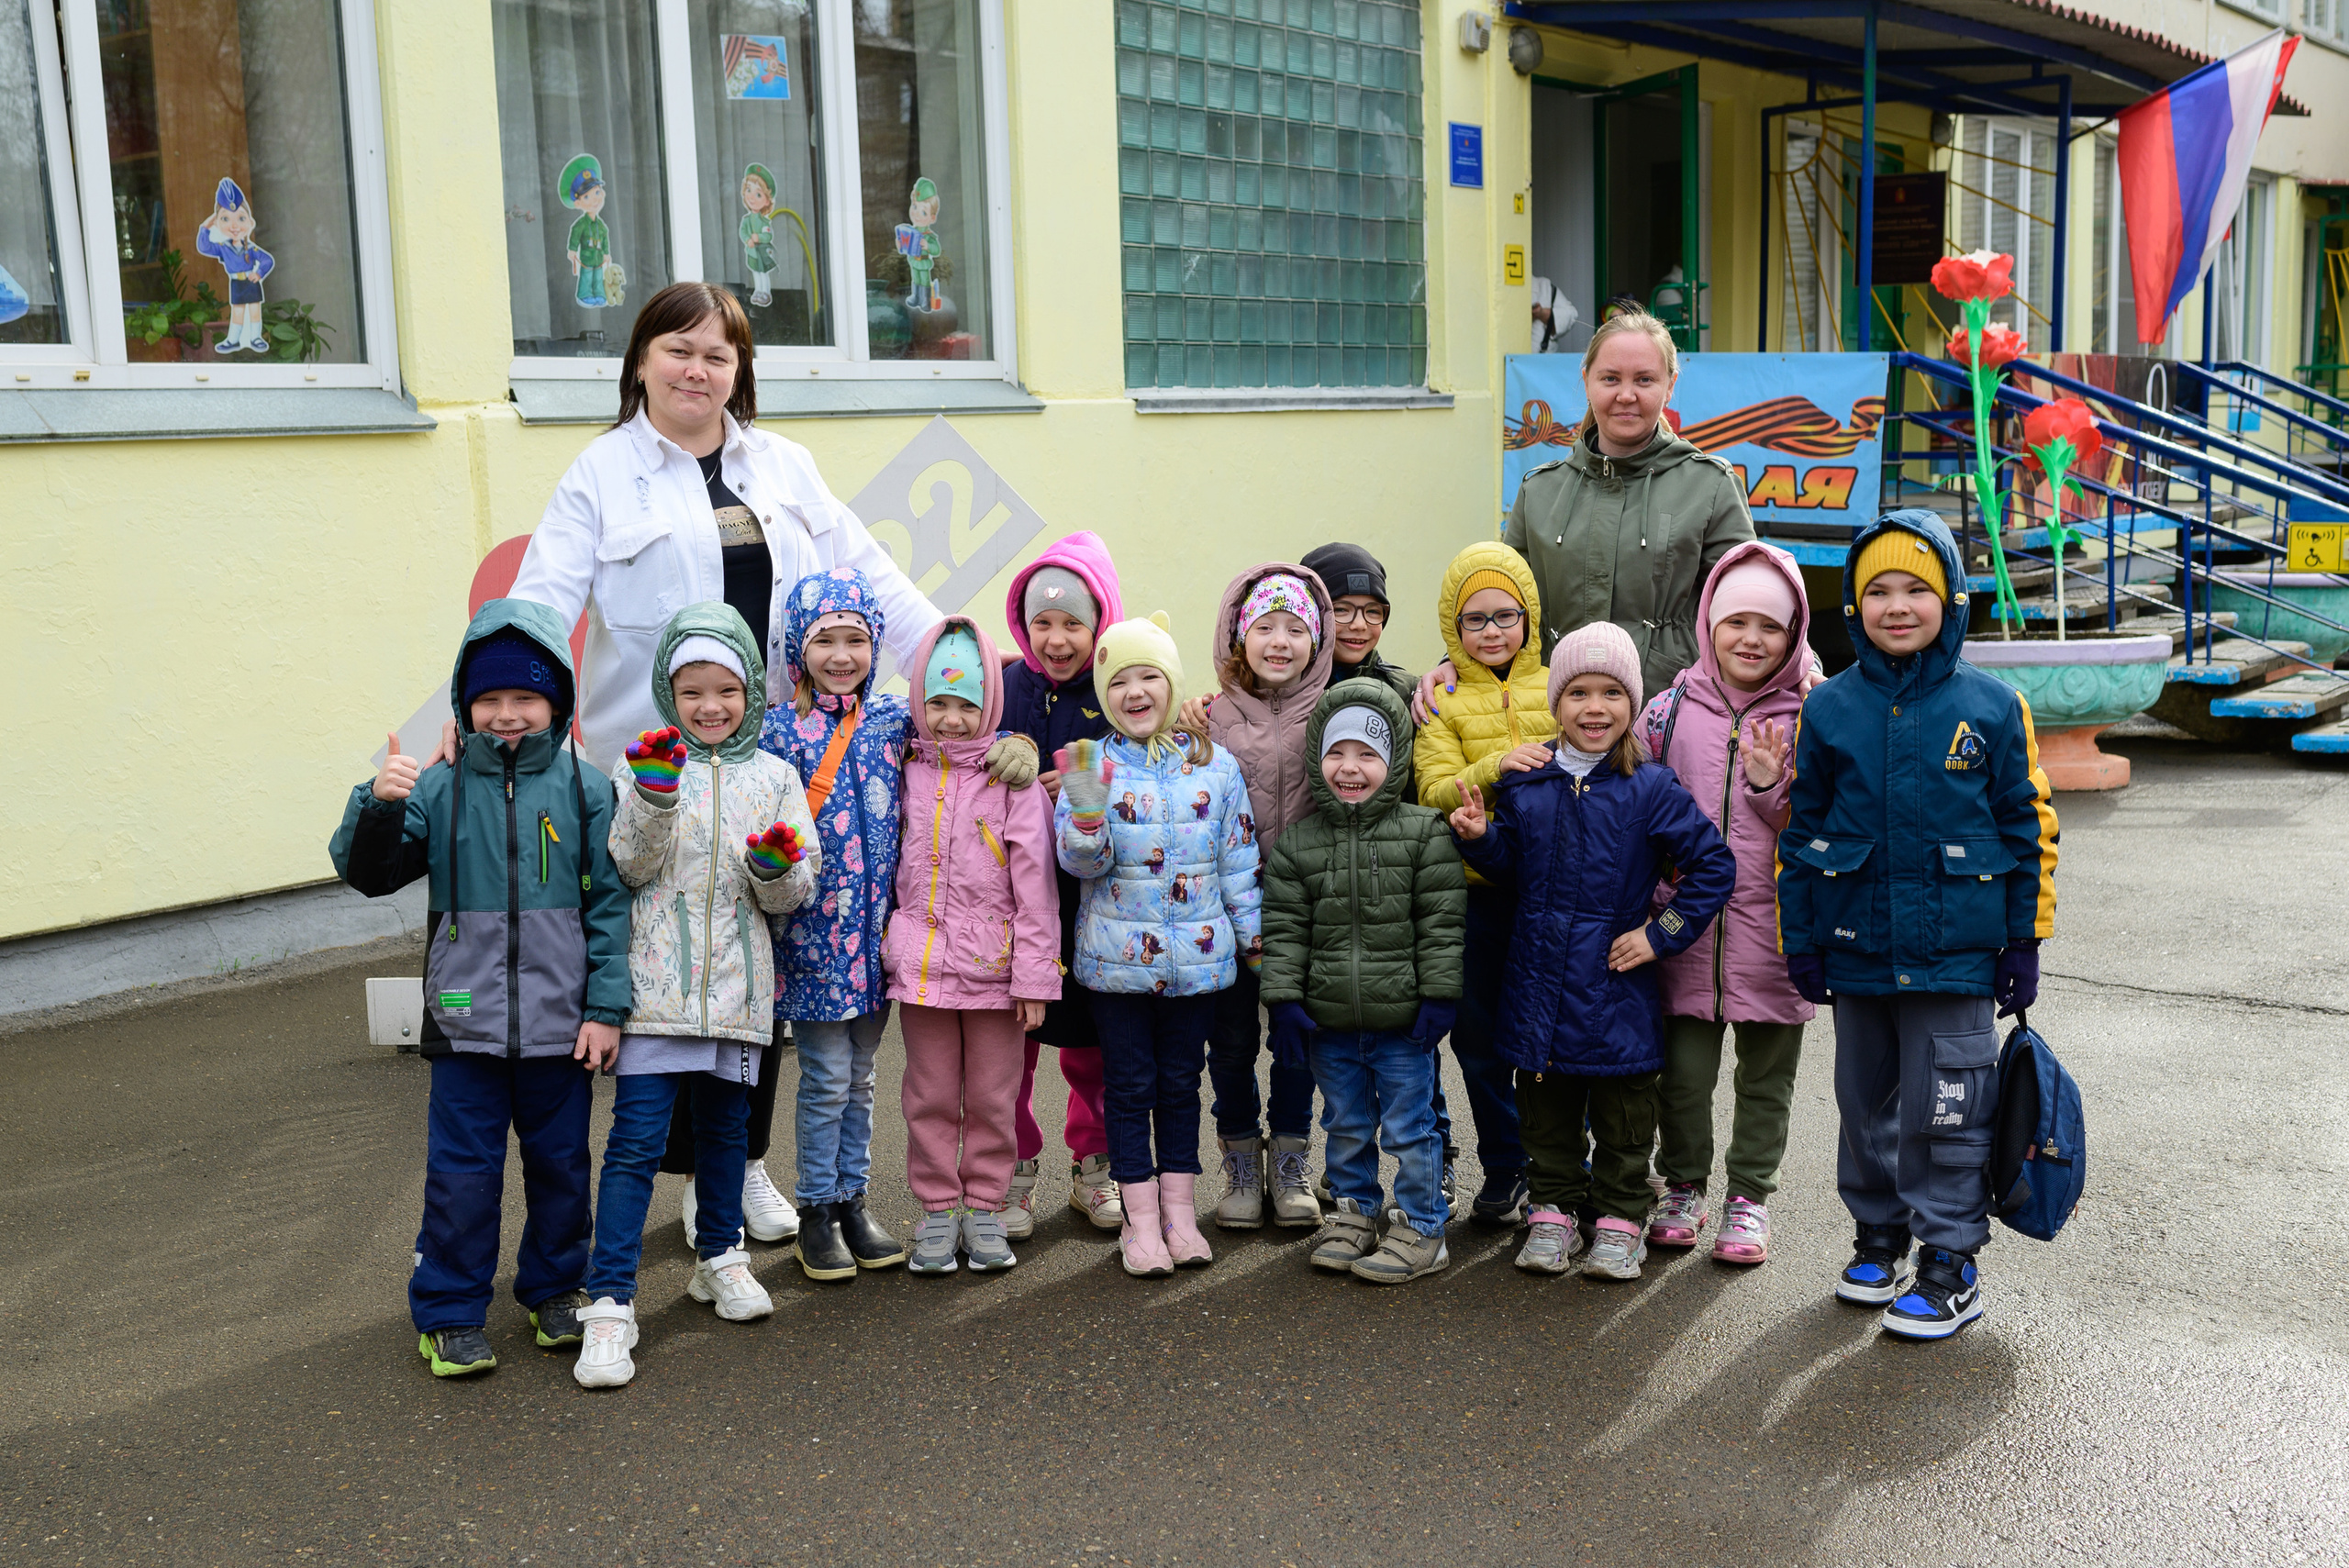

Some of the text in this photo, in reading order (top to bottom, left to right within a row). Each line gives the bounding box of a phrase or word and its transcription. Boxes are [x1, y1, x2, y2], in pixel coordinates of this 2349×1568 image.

[1365, 715, 1391, 751] 84
[1661, 917, 1677, 932] ROSE
[741, 1062, 750, 1084] LOV
[1937, 1079, 1965, 1102] Stay
[1935, 1100, 1946, 1114] in
[1932, 1111, 1964, 1126] reality
